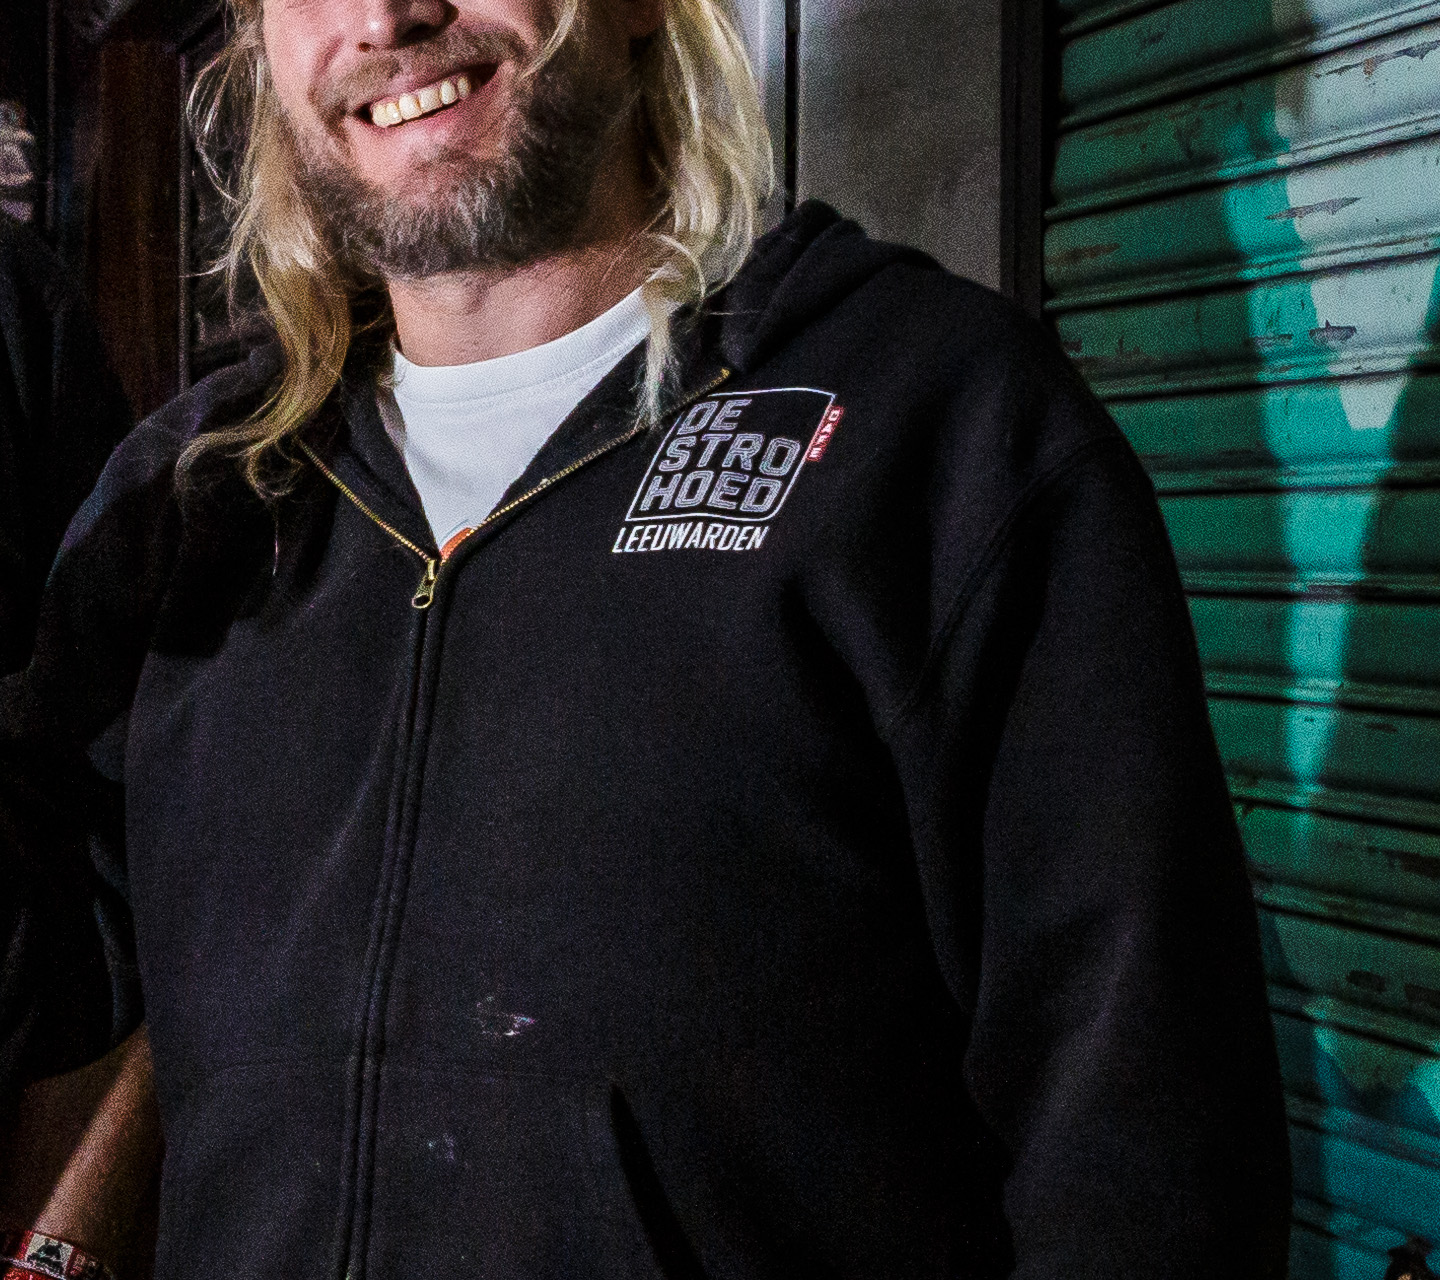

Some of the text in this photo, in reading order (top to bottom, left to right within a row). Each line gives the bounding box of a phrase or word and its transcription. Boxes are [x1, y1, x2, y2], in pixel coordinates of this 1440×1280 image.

[678, 399, 752, 435] DE
[658, 433, 802, 477] STRO
[639, 471, 783, 513] HOED
[611, 520, 769, 554] LEEUWARDEN
